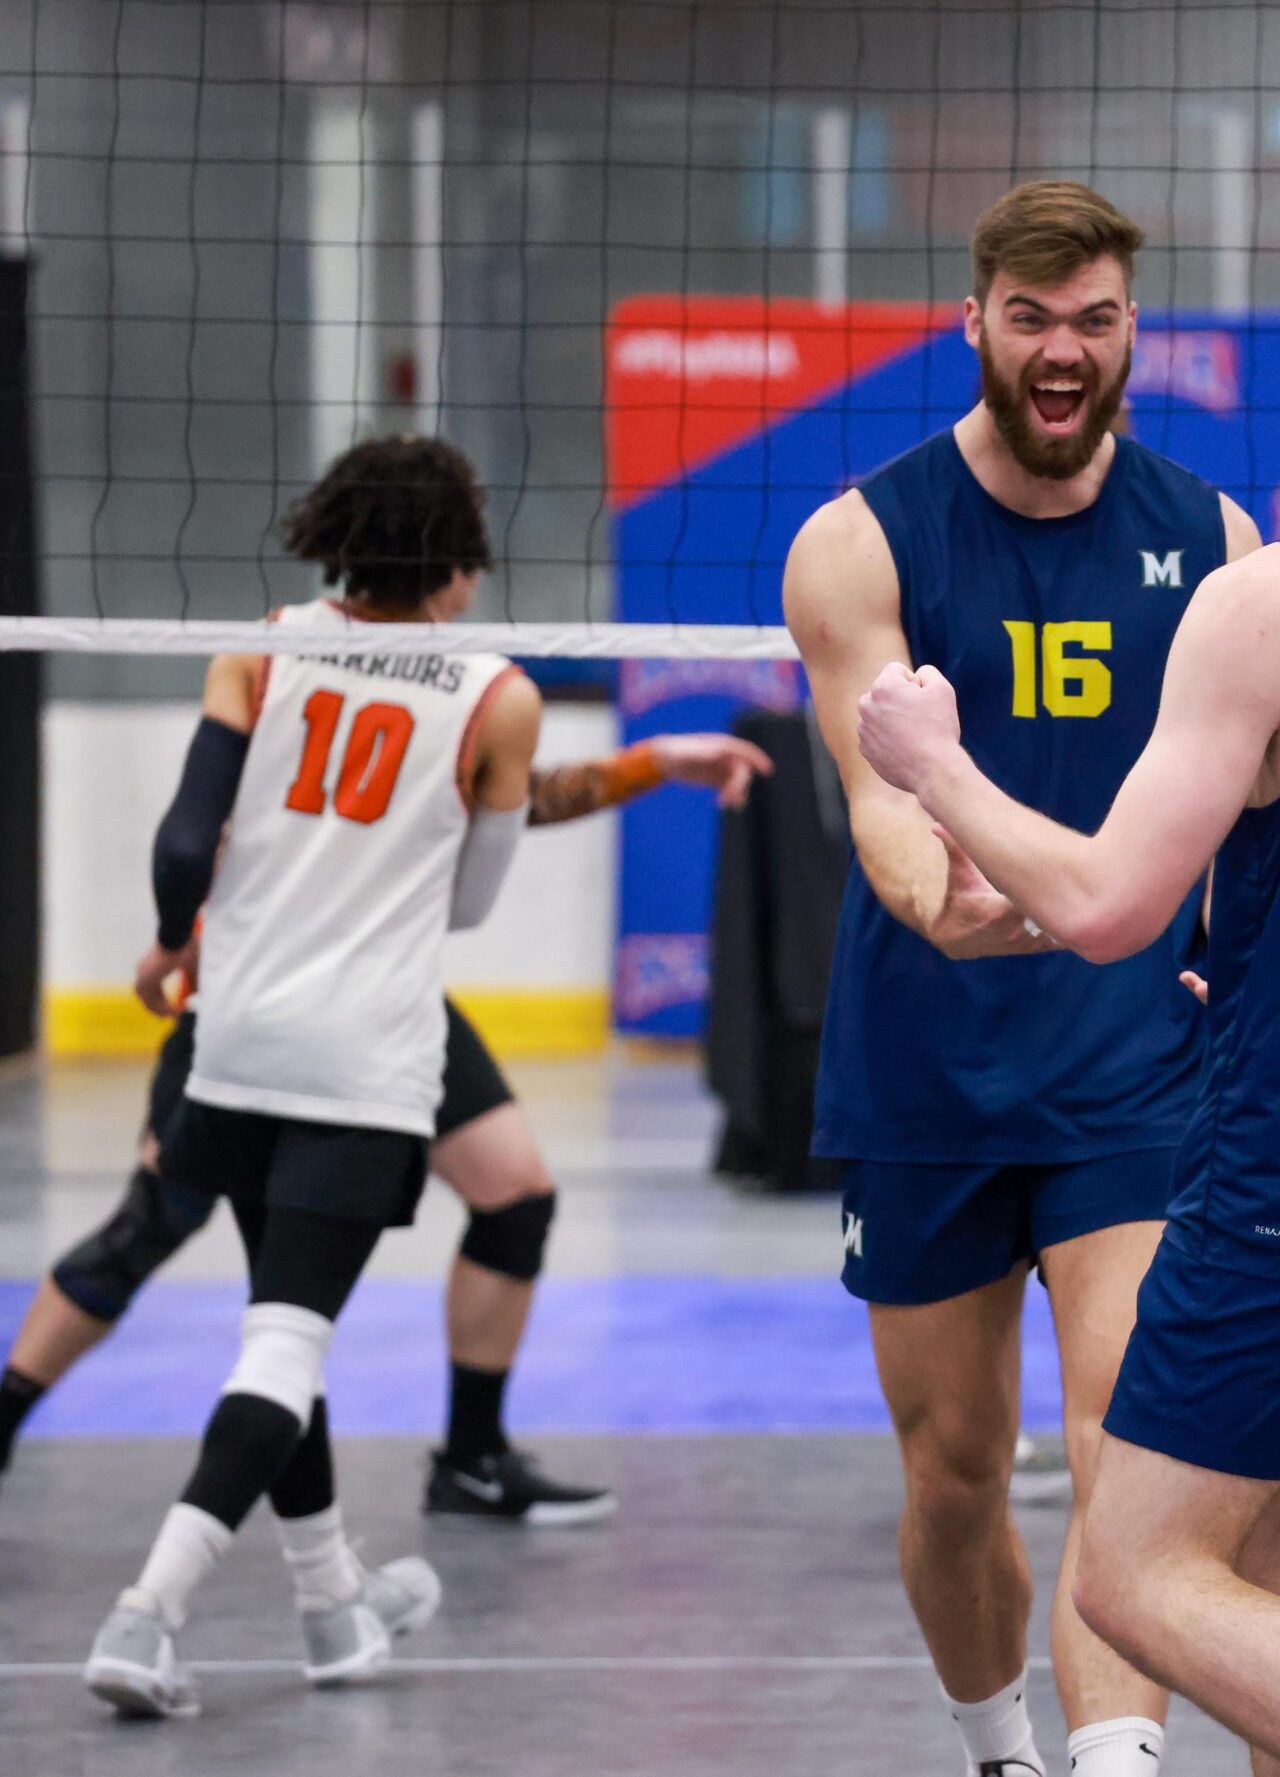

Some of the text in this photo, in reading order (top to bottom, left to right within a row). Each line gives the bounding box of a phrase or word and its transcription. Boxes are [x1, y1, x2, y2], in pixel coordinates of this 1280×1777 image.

[1138, 549, 1186, 588] M
[1002, 620, 1113, 719] 16
[285, 687, 416, 826] 10
